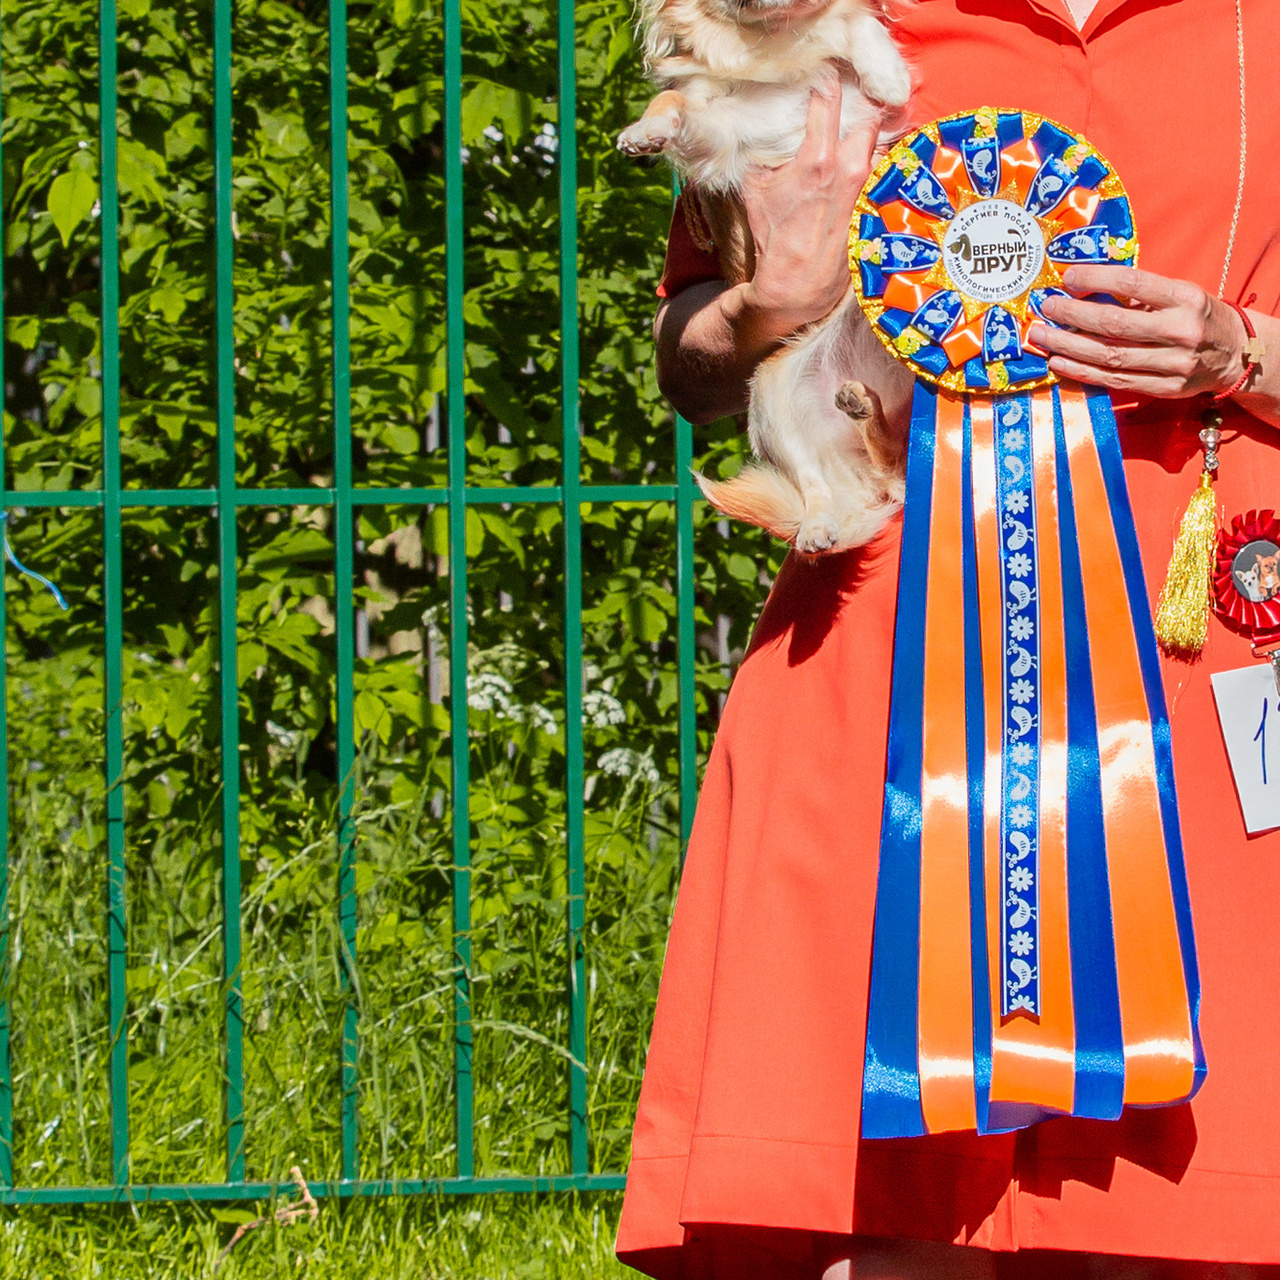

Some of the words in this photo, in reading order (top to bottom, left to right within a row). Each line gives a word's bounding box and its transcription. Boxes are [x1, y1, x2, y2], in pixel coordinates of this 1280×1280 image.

[961, 210, 998, 231] СЕРГИЕВ
[1004, 212, 1030, 236] ПОСАД
[972, 241, 1027, 256] ВЕРНЫЙ
[954, 256, 1024, 293] КИНОЛОГИЧЕСКИЙ
[1023, 244, 1034, 274] ЦЕНТР
[969, 253, 1027, 275] ДРУГ
